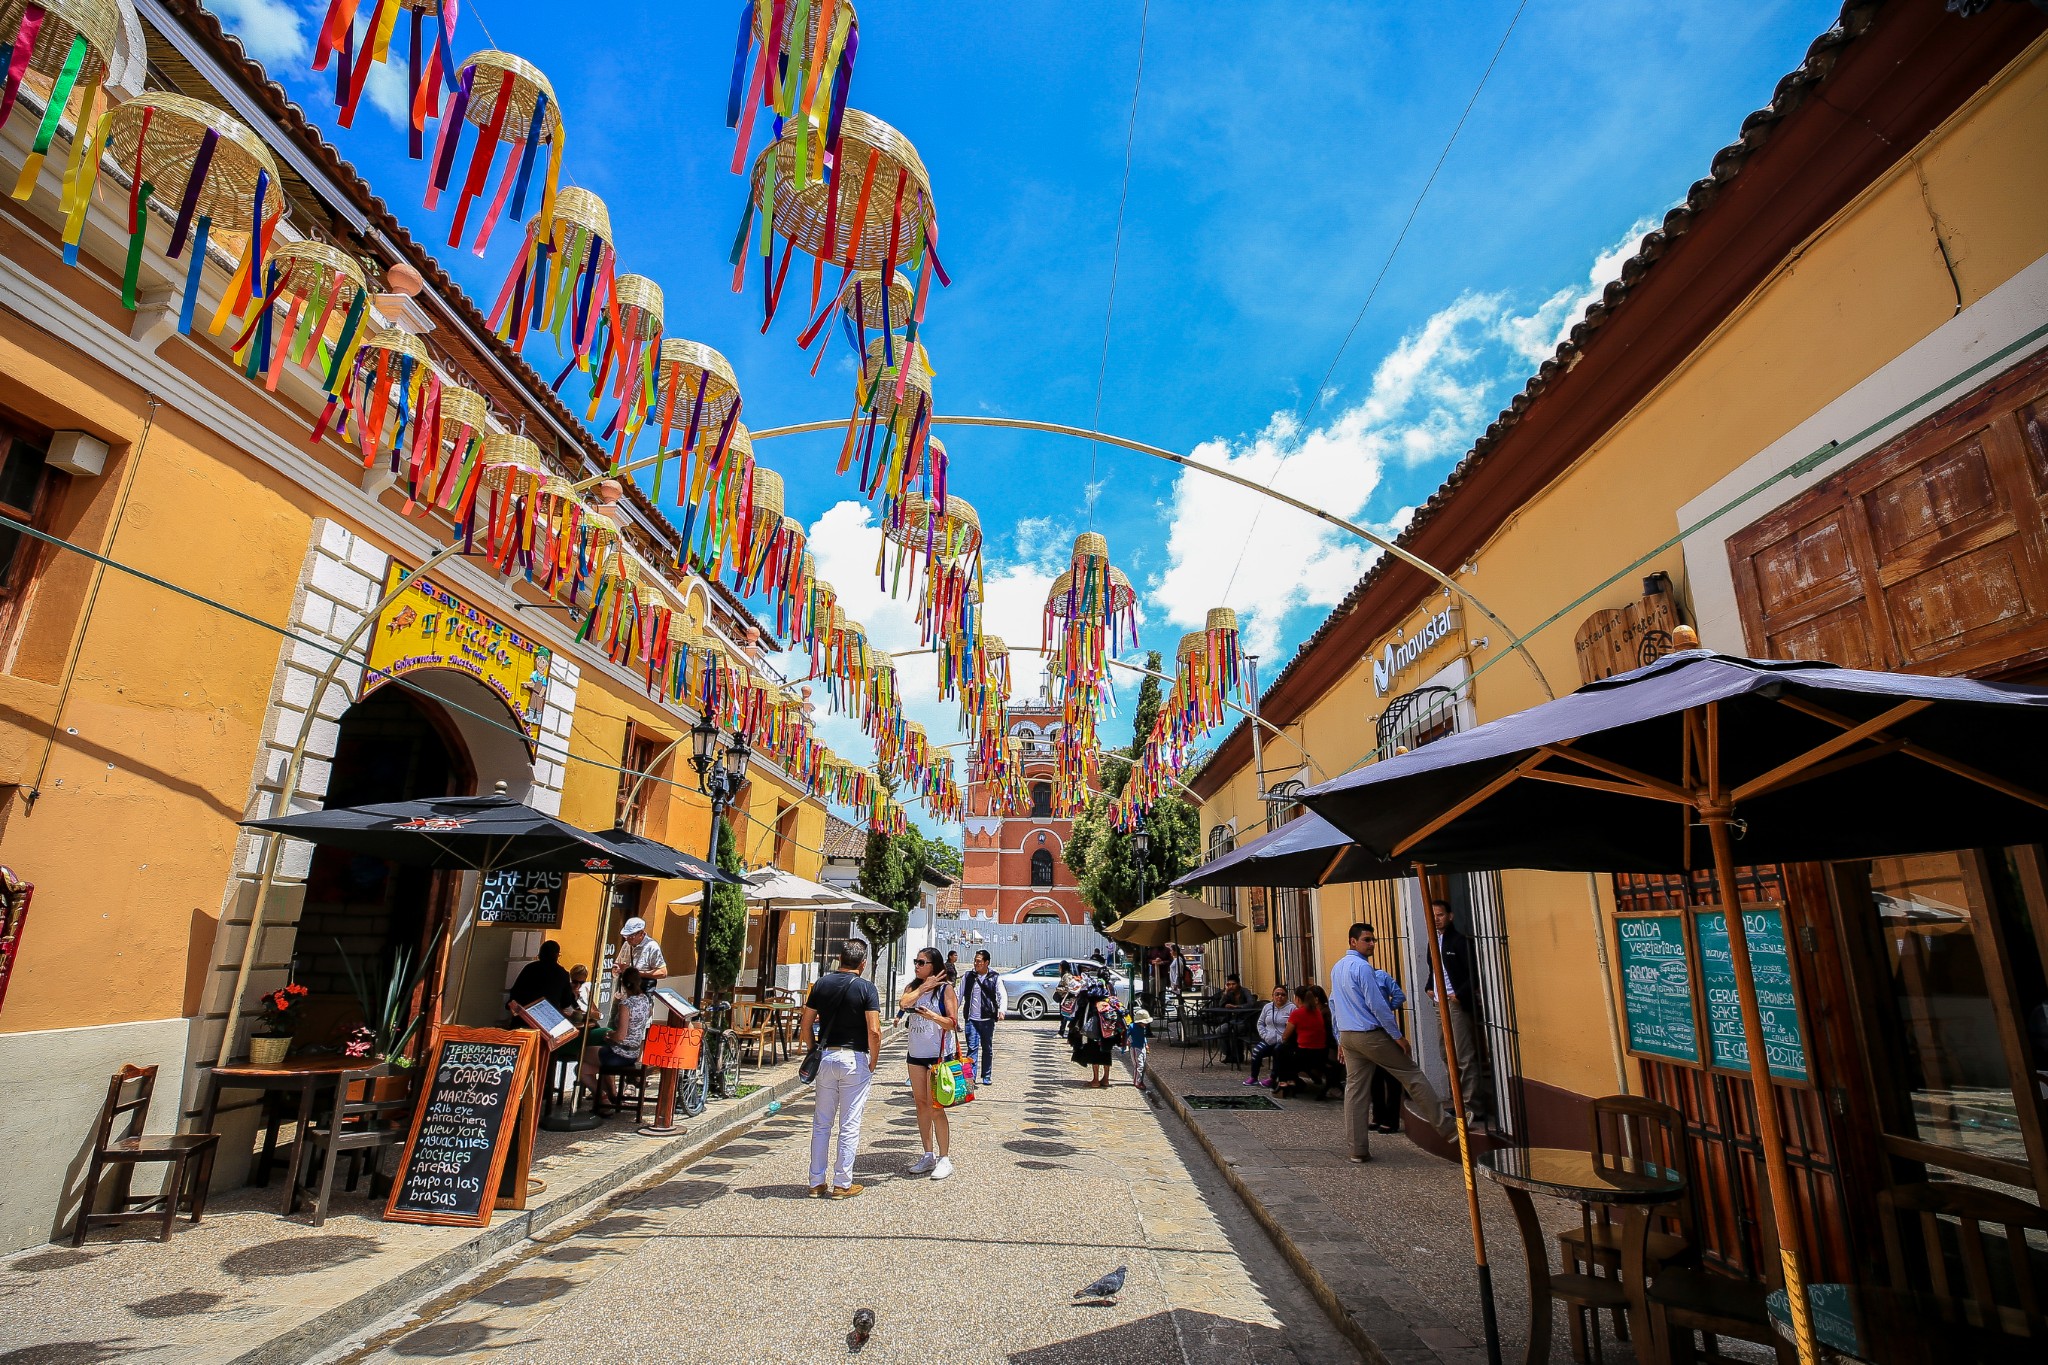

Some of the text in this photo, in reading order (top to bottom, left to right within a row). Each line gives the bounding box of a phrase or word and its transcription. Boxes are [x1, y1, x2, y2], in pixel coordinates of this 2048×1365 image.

[421, 612, 512, 666] El Pescador
[1396, 605, 1452, 671] movistar
[1576, 614, 1621, 653] Restaurant
[484, 871, 562, 889] CREPAS
[500, 885, 515, 895] LA
[480, 890, 551, 912] GALESA
[481, 910, 517, 921] CREPAS
[1709, 988, 1740, 1003] CERVE
[1711, 1005, 1739, 1020] SAKE
[648, 1024, 701, 1047] CREPAS
[664, 1044, 674, 1055] &
[446, 1054, 459, 1063] EL
[453, 1069, 502, 1085] CARNES
[436, 1090, 498, 1106] MARISCOS
[455, 1106, 474, 1116] eye
[427, 1124, 485, 1139] New York
